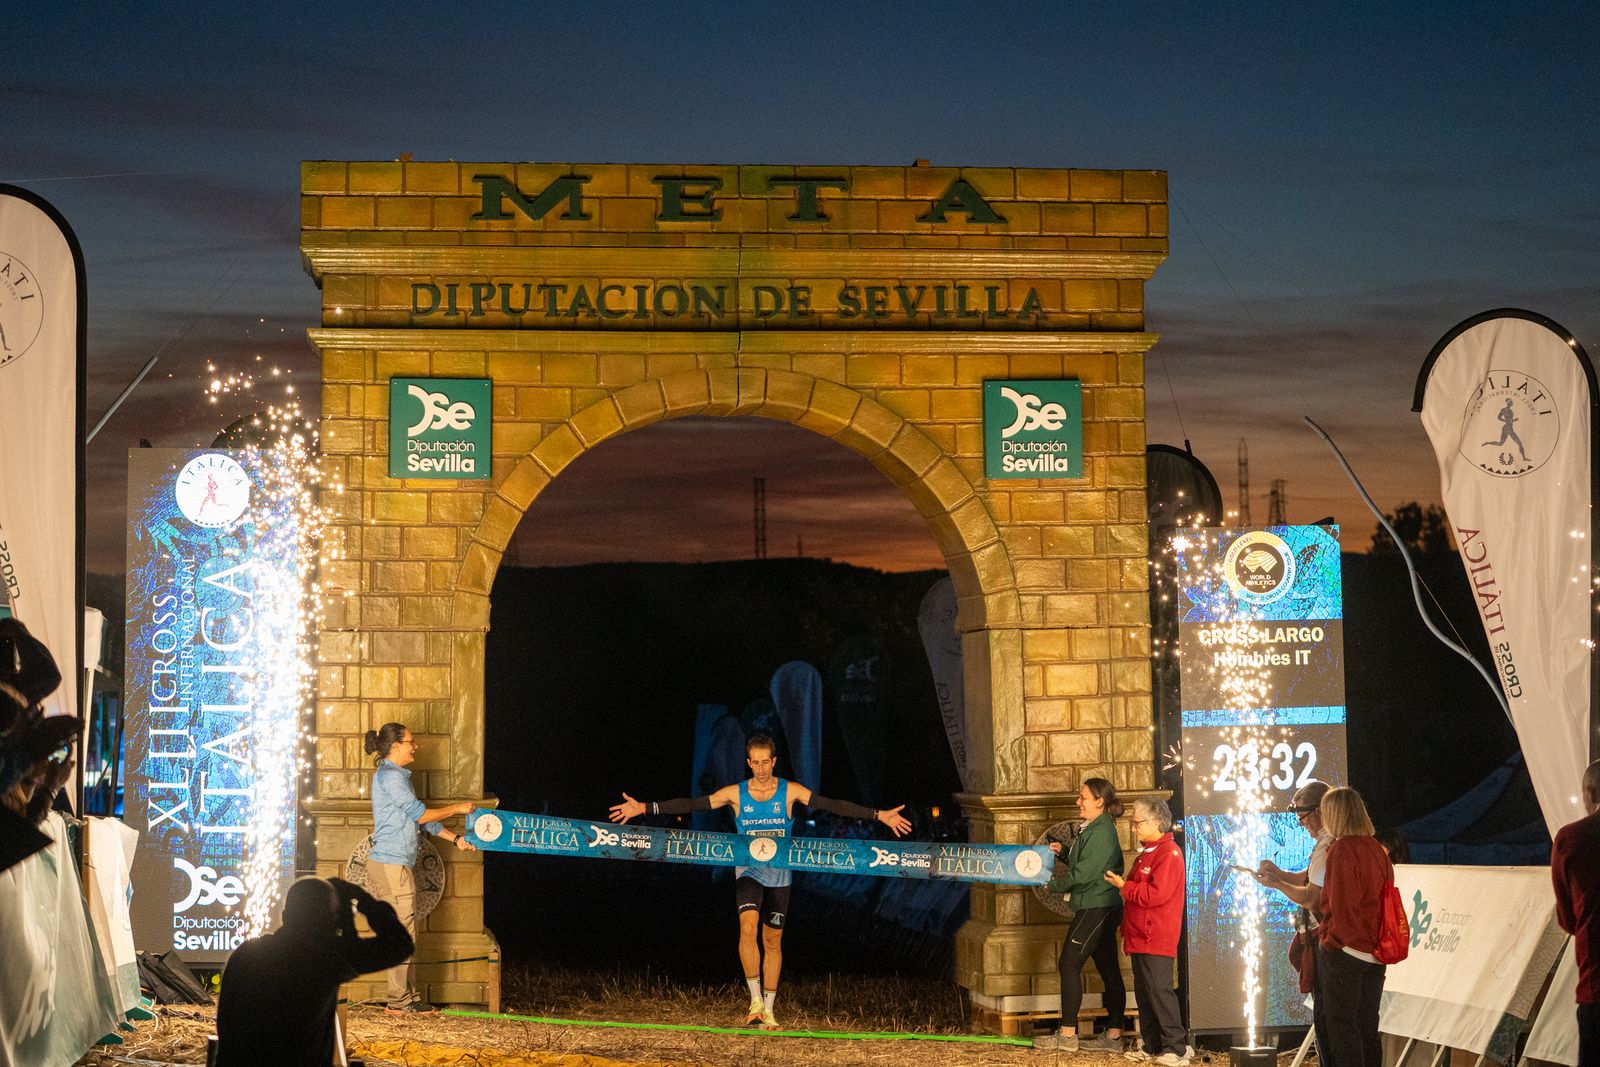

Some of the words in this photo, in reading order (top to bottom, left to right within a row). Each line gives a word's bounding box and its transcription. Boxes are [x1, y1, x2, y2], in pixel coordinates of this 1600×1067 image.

[471, 174, 1007, 224] META
[410, 283, 727, 320] DIPUTACION
[753, 286, 813, 320] DE
[837, 286, 1049, 321] SEVILLA
[407, 439, 475, 455] Diputación
[1002, 440, 1068, 455] Diputación
[407, 454, 475, 473] Sevilla
[1002, 455, 1068, 473] Sevilla
[180, 555, 196, 701] INTERNACIONAL
[1198, 628, 1260, 645] CROSS
[1264, 626, 1324, 643] LARGO
[152, 594, 178, 701] CROSS
[1214, 650, 1291, 667] Hombres
[1295, 649, 1311, 665] IT
[545, 819, 572, 828] CROSS
[620, 839, 651, 849] Sevilla
[621, 832, 652, 841] Diputación
[822, 841, 849, 849] CROSS
[901, 852, 931, 860] Diputación
[971, 848, 997, 856] CROSS
[901, 858, 930, 868] Sevilla
[173, 915, 245, 930] Diputación
[173, 931, 245, 950] Sevilla
[1424, 928, 1461, 953] Sevilla
